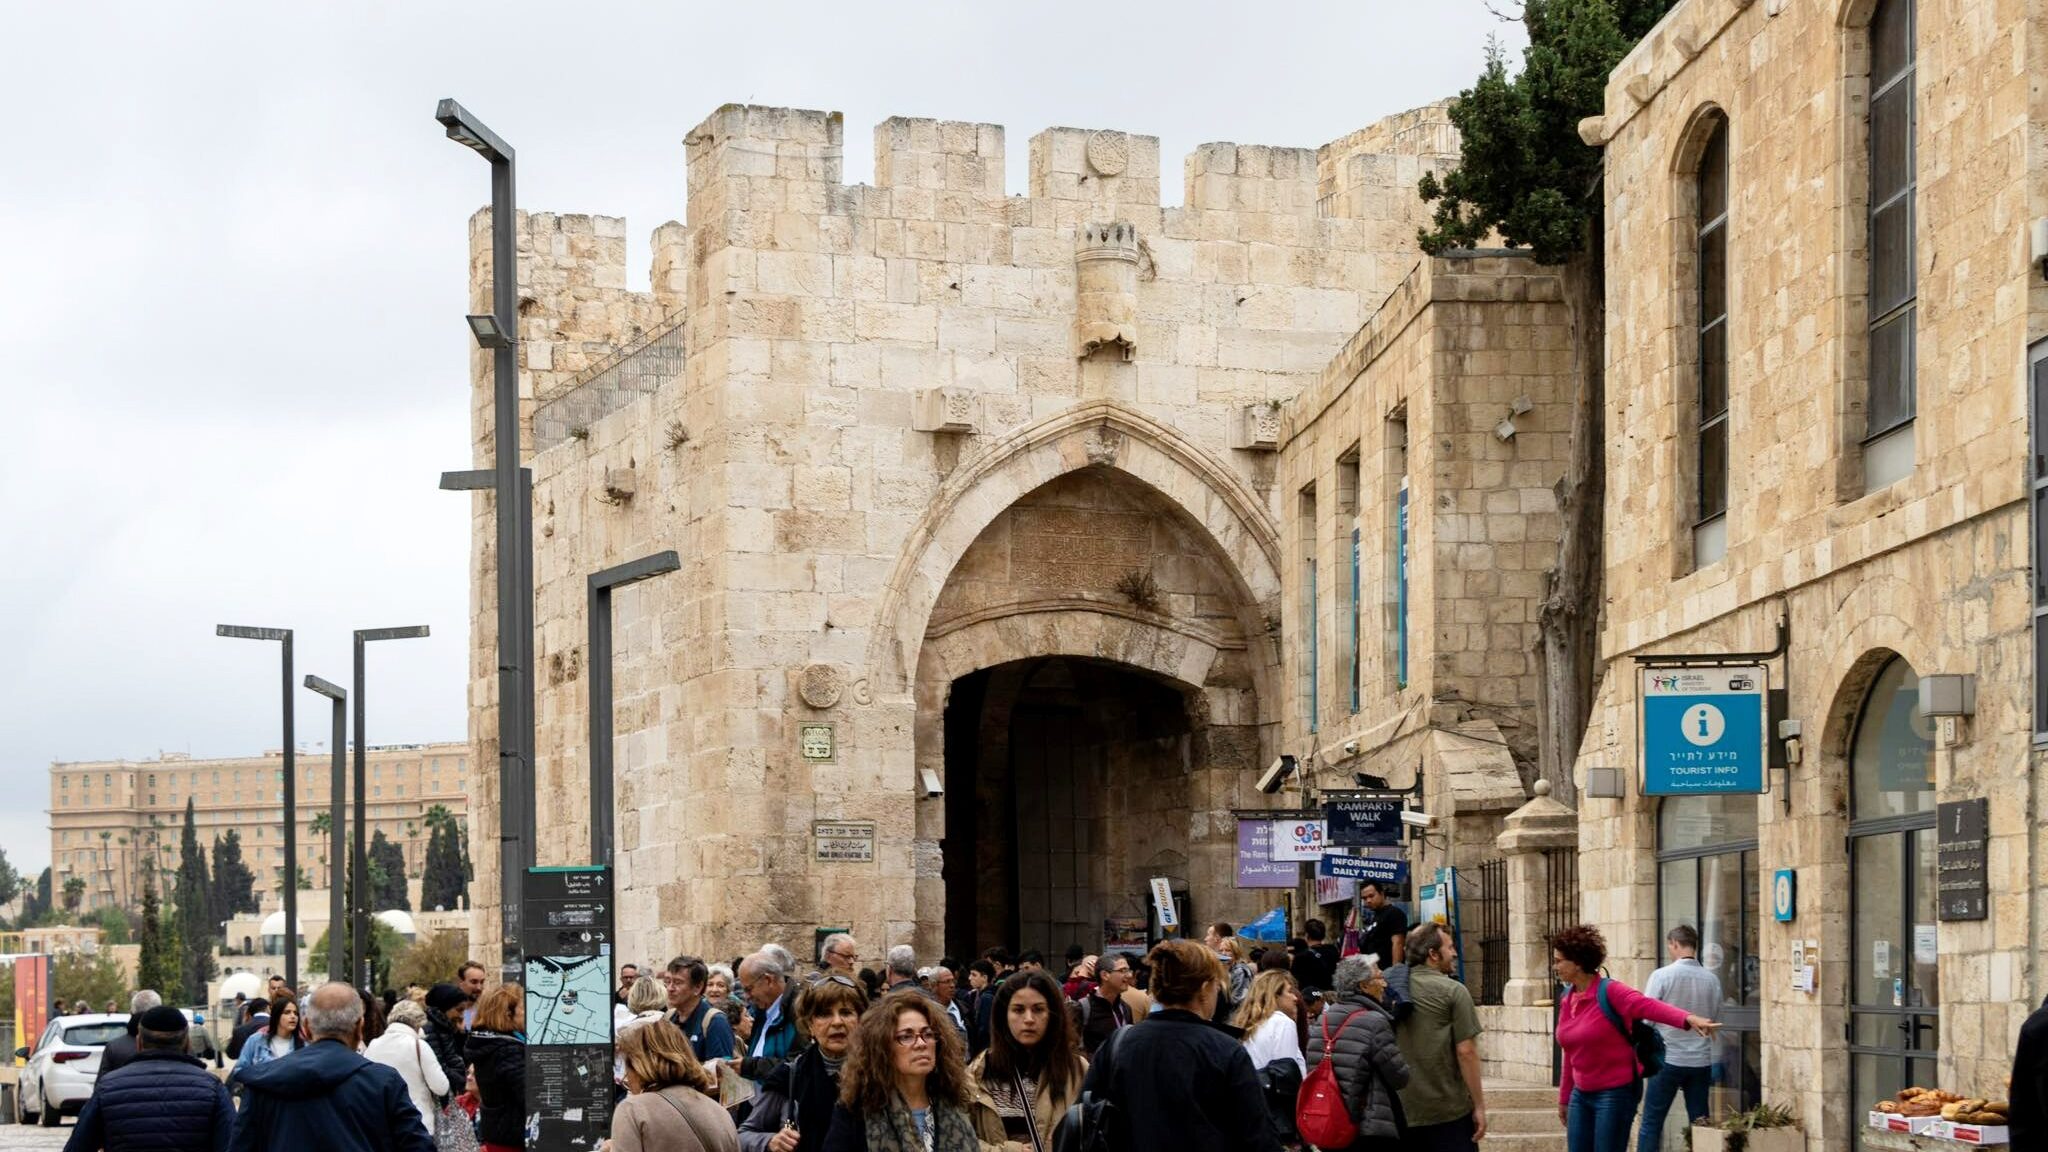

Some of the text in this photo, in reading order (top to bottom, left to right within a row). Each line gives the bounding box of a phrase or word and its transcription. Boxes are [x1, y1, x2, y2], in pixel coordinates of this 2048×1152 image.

[1669, 750, 1737, 761] מידע לתייר
[1669, 766, 1738, 775] TOURIST INFO
[1336, 802, 1394, 811] RAMPARTS
[1350, 812, 1381, 822] WALK
[1240, 850, 1252, 859] The
[1331, 857, 1397, 870] INFORMATION
[1333, 867, 1394, 880] DAILY TOURS
